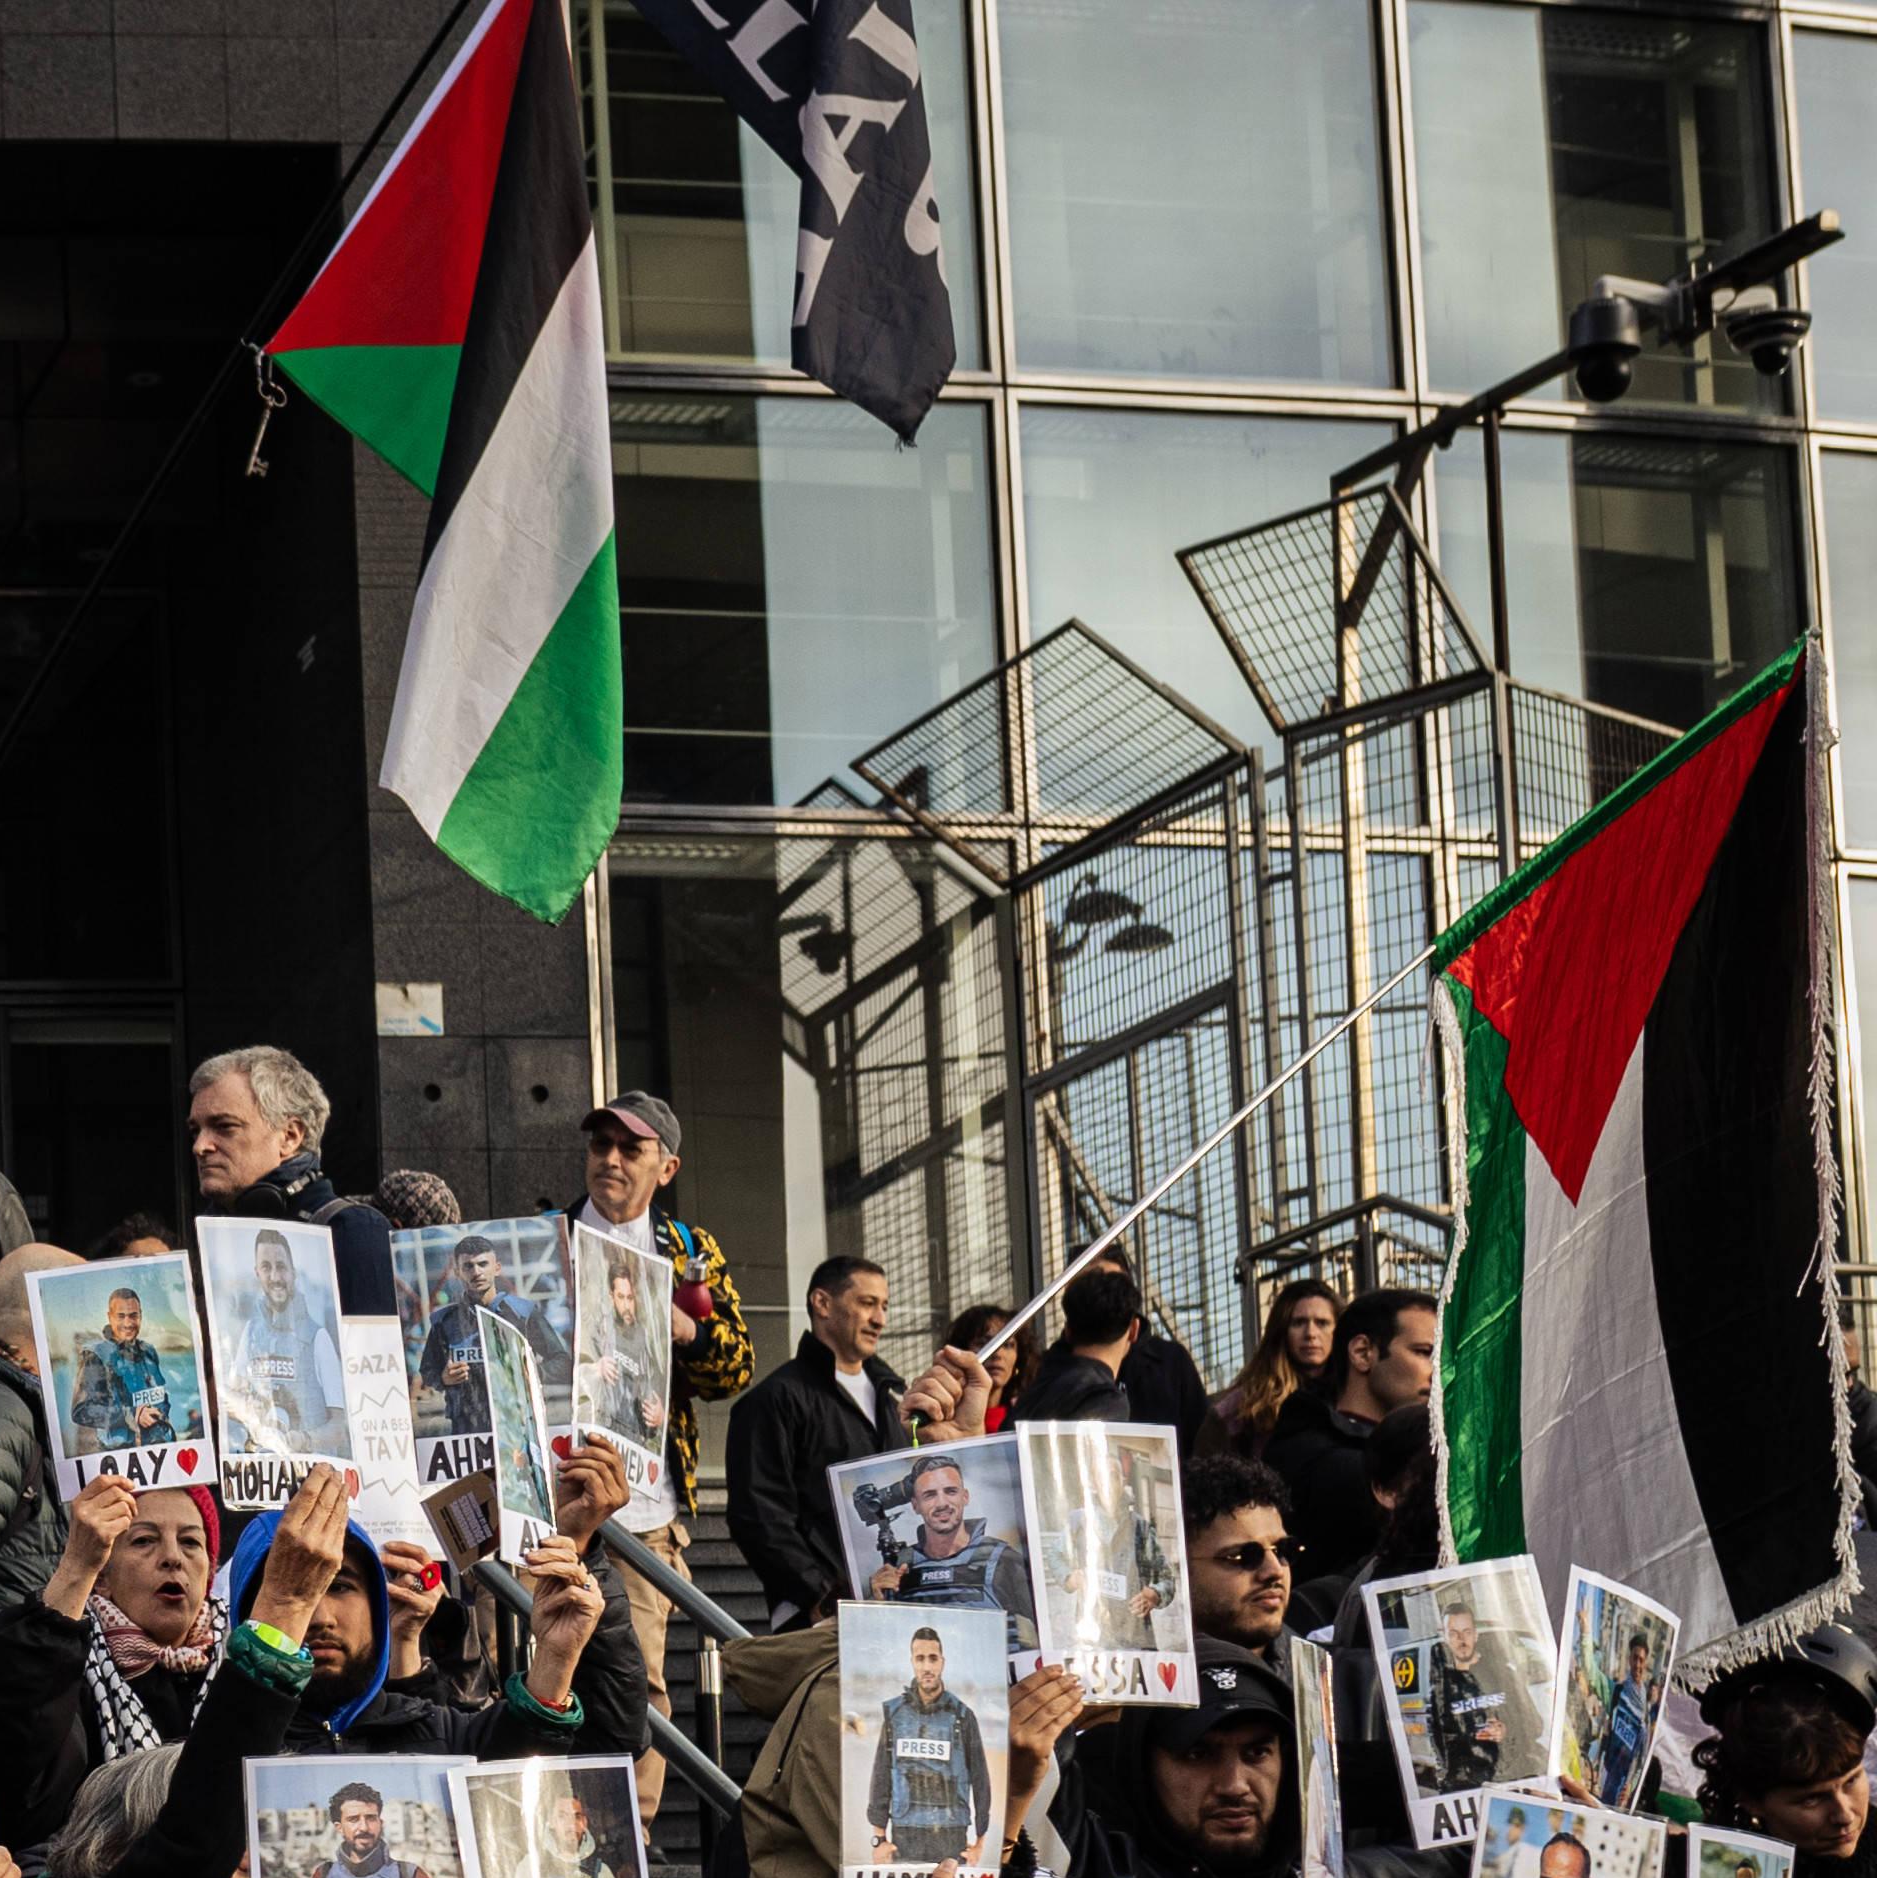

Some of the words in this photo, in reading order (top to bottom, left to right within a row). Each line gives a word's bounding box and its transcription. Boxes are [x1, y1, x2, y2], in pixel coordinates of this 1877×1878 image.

[264, 1356, 294, 1376] PRESS
[347, 1354, 400, 1374] GAZA
[613, 1350, 639, 1376] PRESS
[134, 1389, 164, 1404] PRESS
[362, 1421, 379, 1432] ON
[922, 1568, 952, 1583] PRESS
[1452, 1692, 1506, 1713] PRESS
[901, 1738, 945, 1757] PRESS
